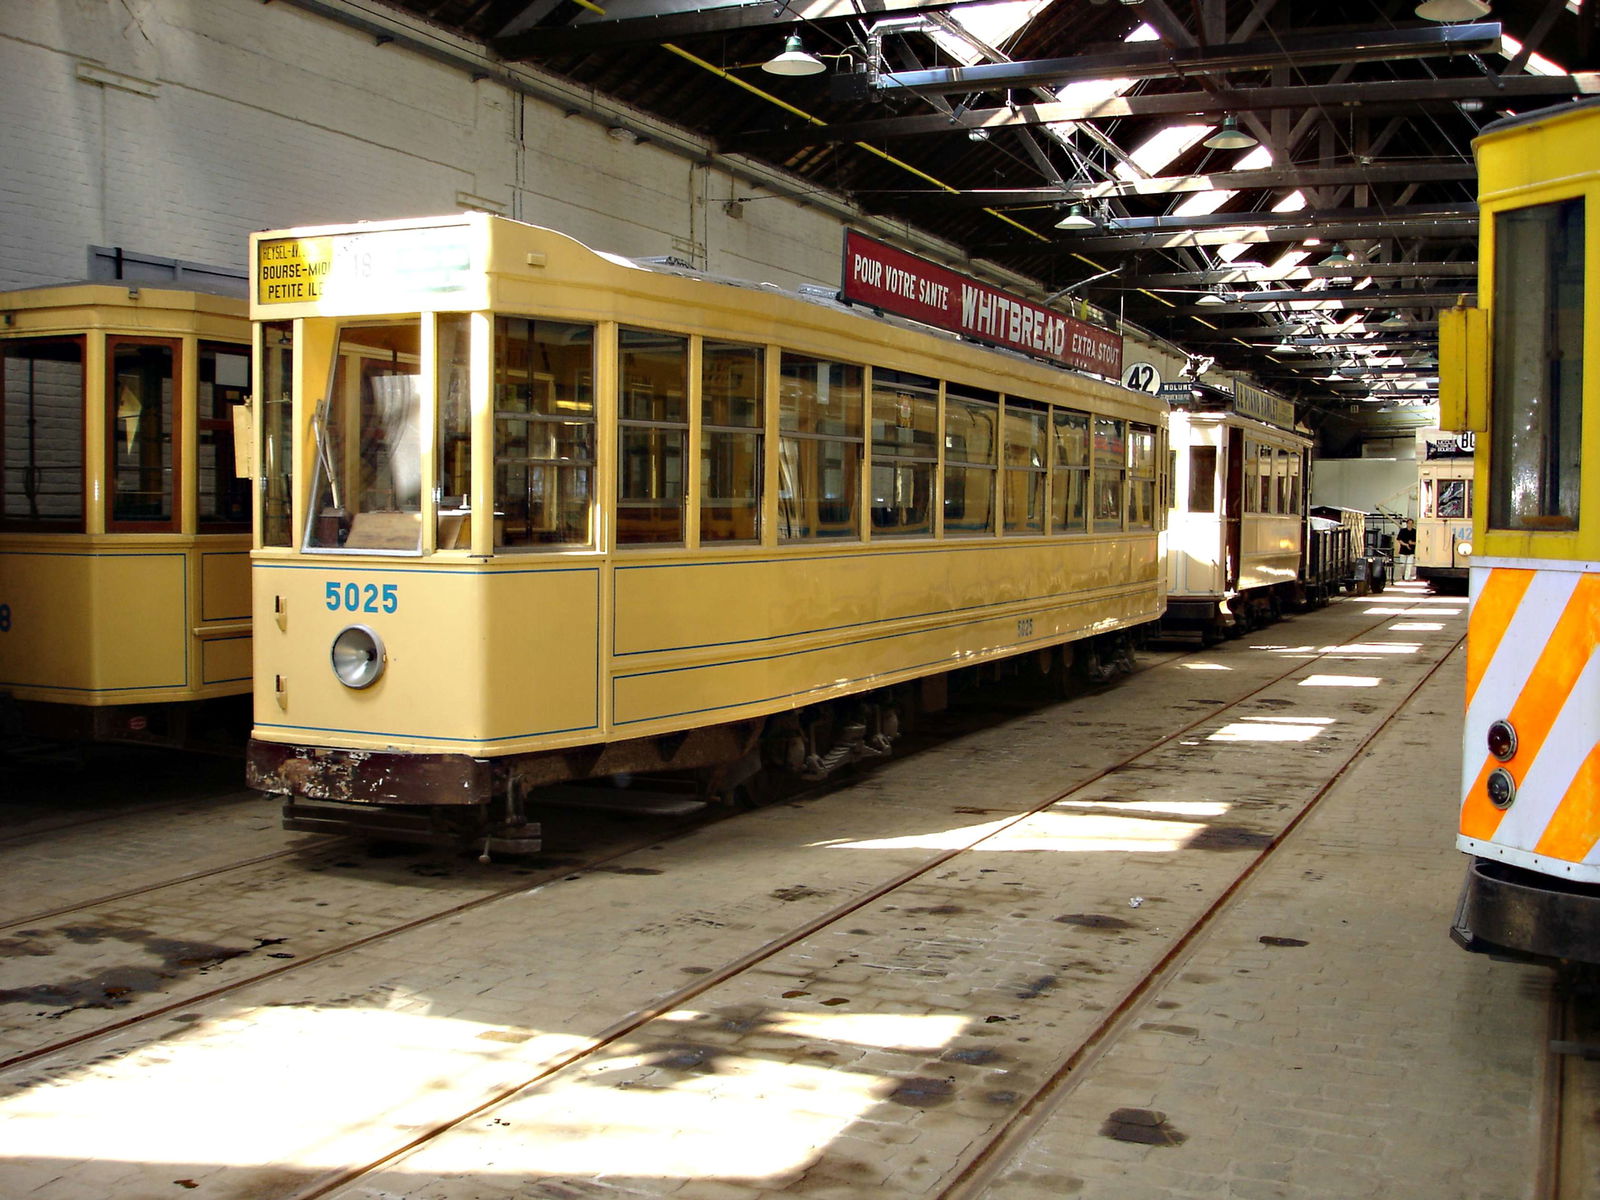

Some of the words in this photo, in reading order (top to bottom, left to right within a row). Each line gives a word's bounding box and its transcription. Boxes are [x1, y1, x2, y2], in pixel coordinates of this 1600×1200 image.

[268, 283, 304, 299] PETITE
[308, 281, 324, 297] ILE
[854, 253, 882, 288] POUR
[885, 265, 916, 300] VOTRE
[919, 278, 949, 311] SANTE
[961, 283, 1065, 356] WHITBREAD
[1071, 332, 1096, 359] EXTRA
[1097, 342, 1120, 365] STOUT
[1127, 365, 1154, 394] 42
[326, 582, 398, 614] 5025
